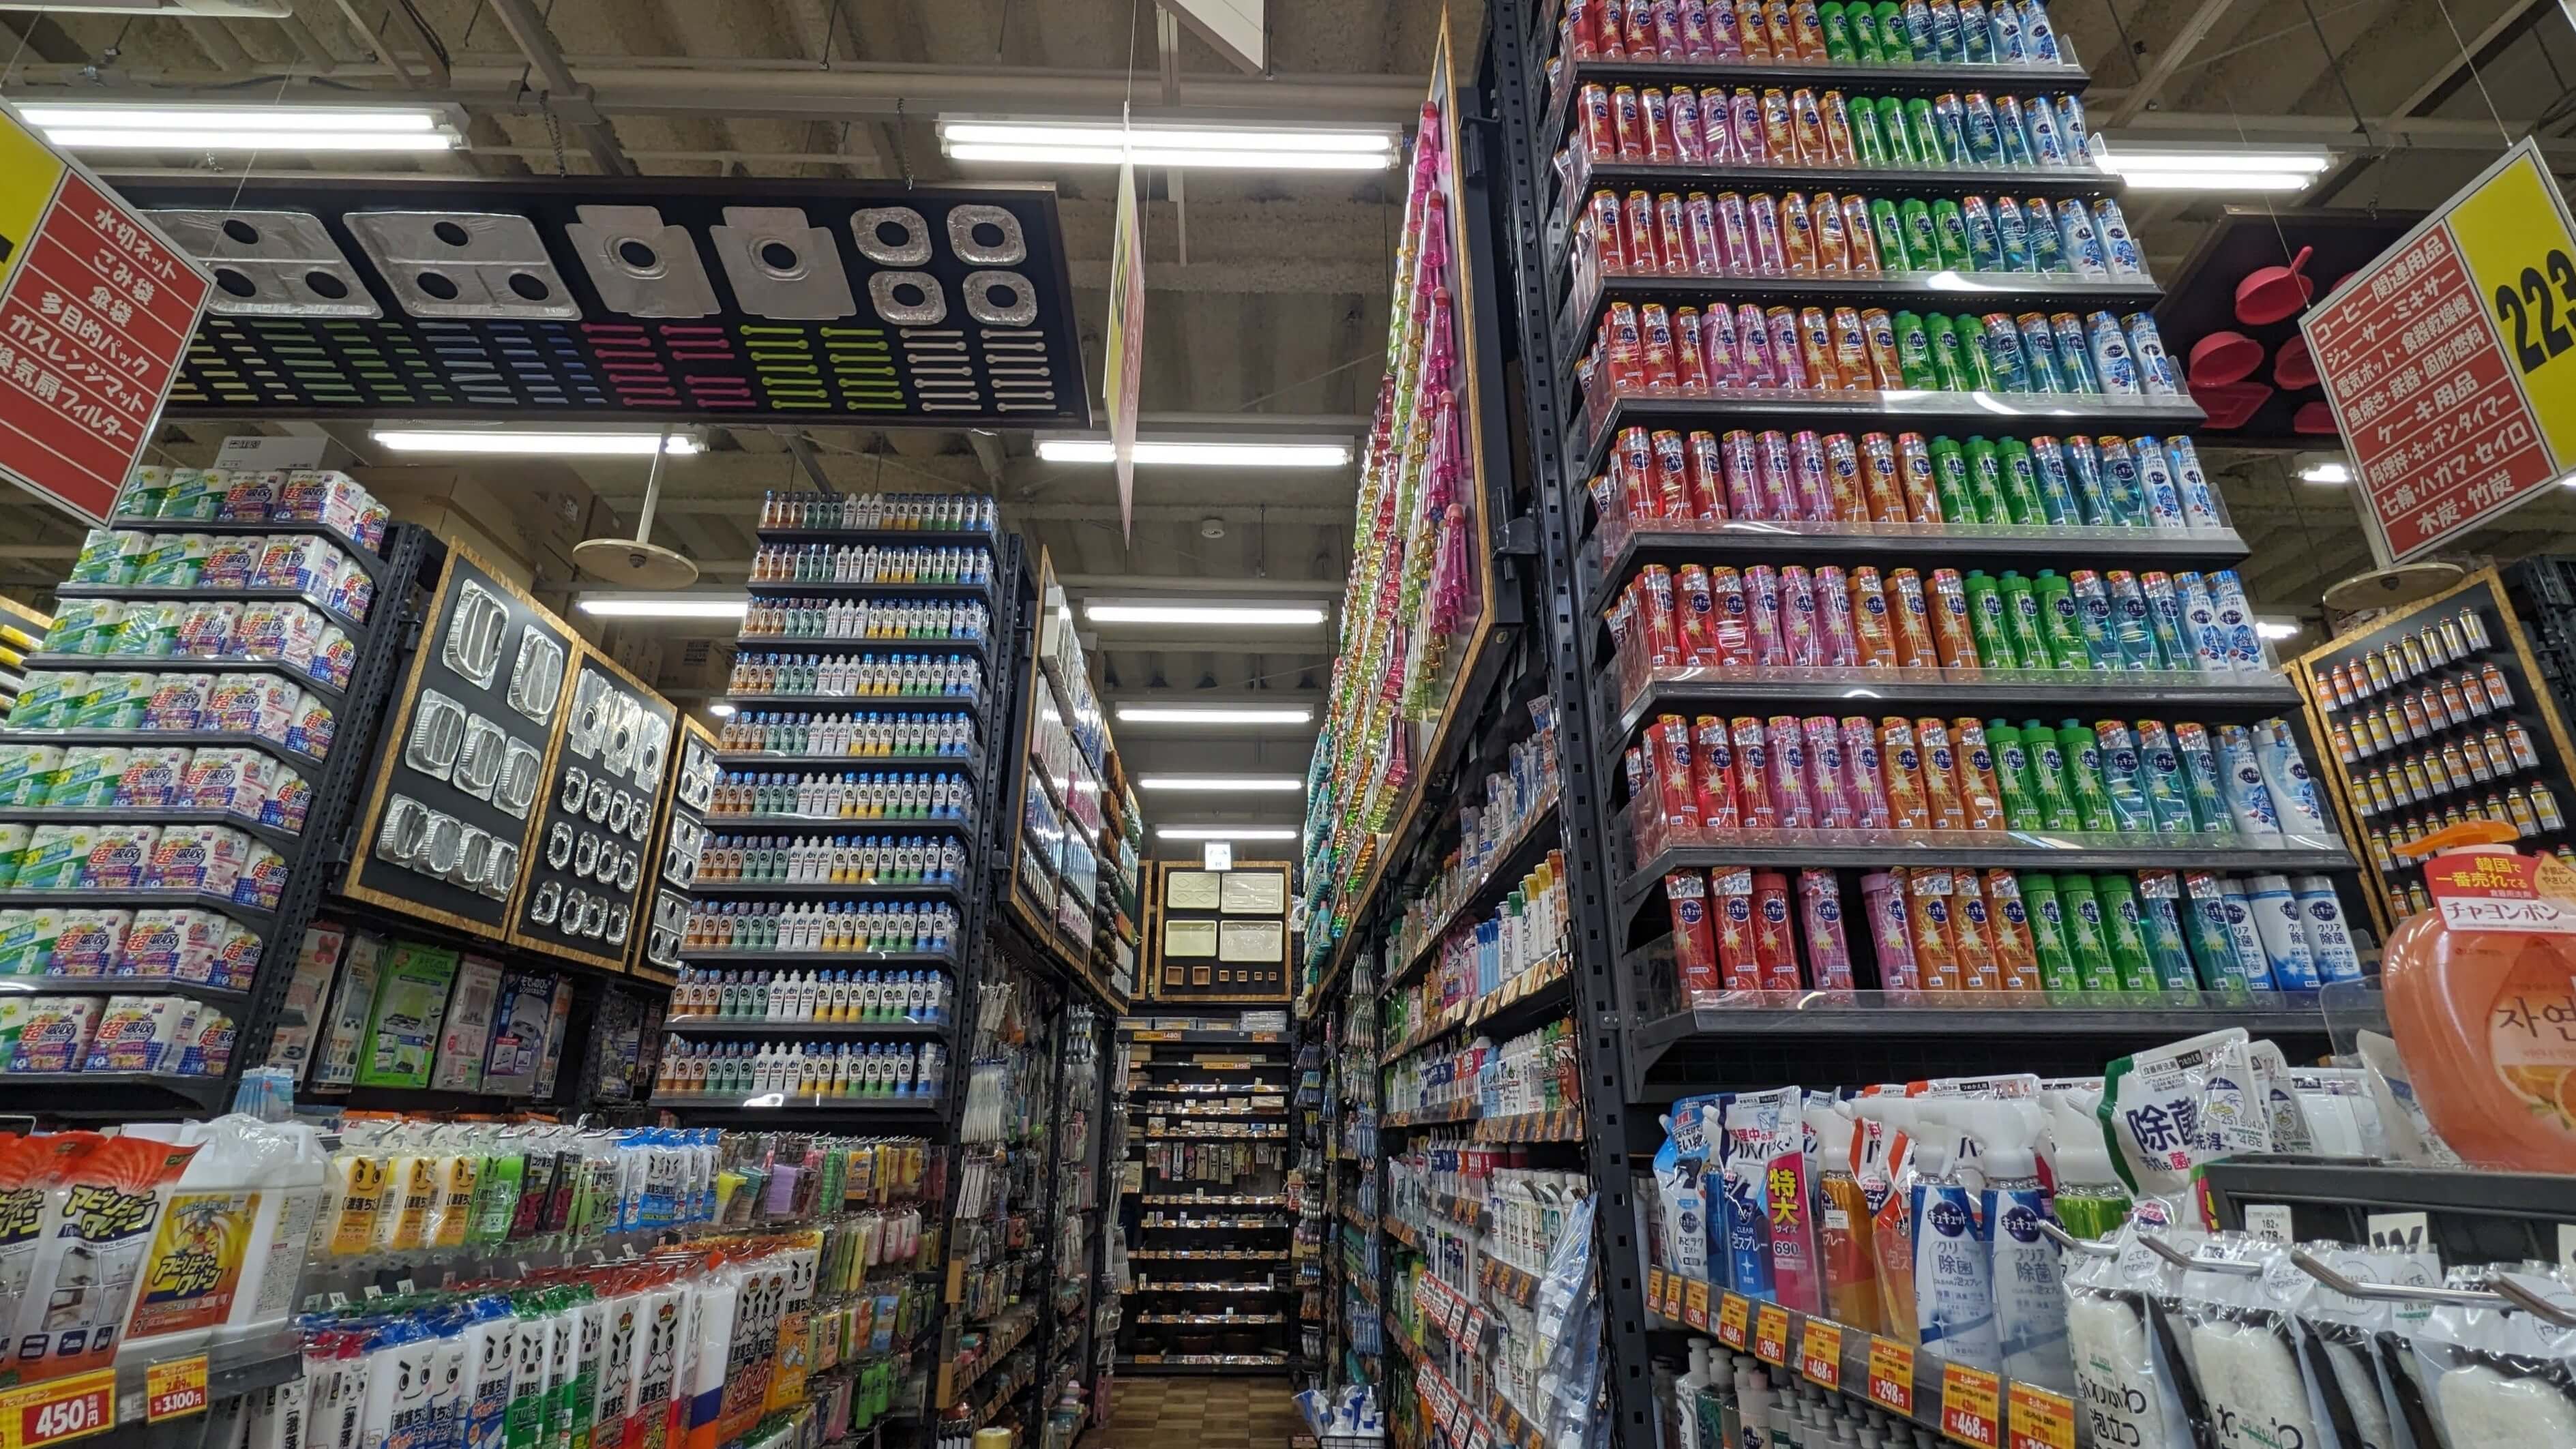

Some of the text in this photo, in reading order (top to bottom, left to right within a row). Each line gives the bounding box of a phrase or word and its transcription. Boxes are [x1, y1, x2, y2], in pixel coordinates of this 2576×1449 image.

[94, 208, 177, 280] 水切ネット
[94, 248, 155, 305] ごみ袋
[2315, 235, 2446, 344] コーヒー関連用品
[88, 286, 133, 327] 傘袋
[2326, 269, 2456, 370] ジューサー・ミキサー
[41, 291, 150, 377] 多目的パック
[2336, 293, 2472, 398] 電気ポット・食器乾燥機
[8, 314, 145, 412] ガスレンジマット
[0, 344, 135, 442] 換気扇フィルター
[2377, 370, 2478, 444] ケーキ用品
[2369, 394, 2511, 489] 料理秤・キッチンタイマー
[2382, 420, 2530, 517] 七輪・ハガマ・セイロ
[2416, 468, 2515, 535] 木炭・竹炭
[2436, 871, 2528, 889] 一番売れてる
[2474, 856, 2521, 873] 韓国で
[2317, 923, 2341, 932] クリア
[2446, 901, 2560, 922] チャヨンポン
[55, 932, 109, 954] 超吸収
[124, 932, 179, 954] 超吸収
[2318, 933, 2347, 945] 除菌
[20, 1023, 76, 1043] 超吸収
[96, 1021, 157, 1043] 超吸収
[1769, 1167, 1800, 1225] 特大
[1736, 1226, 1754, 1235] CLEAR
[1927, 1210, 1968, 1225] キュキュット
[1938, 1255, 1974, 1276] 除菌
[2015, 1262, 2053, 1283] 除菌
[35, 1399, 86, 1438] 450
